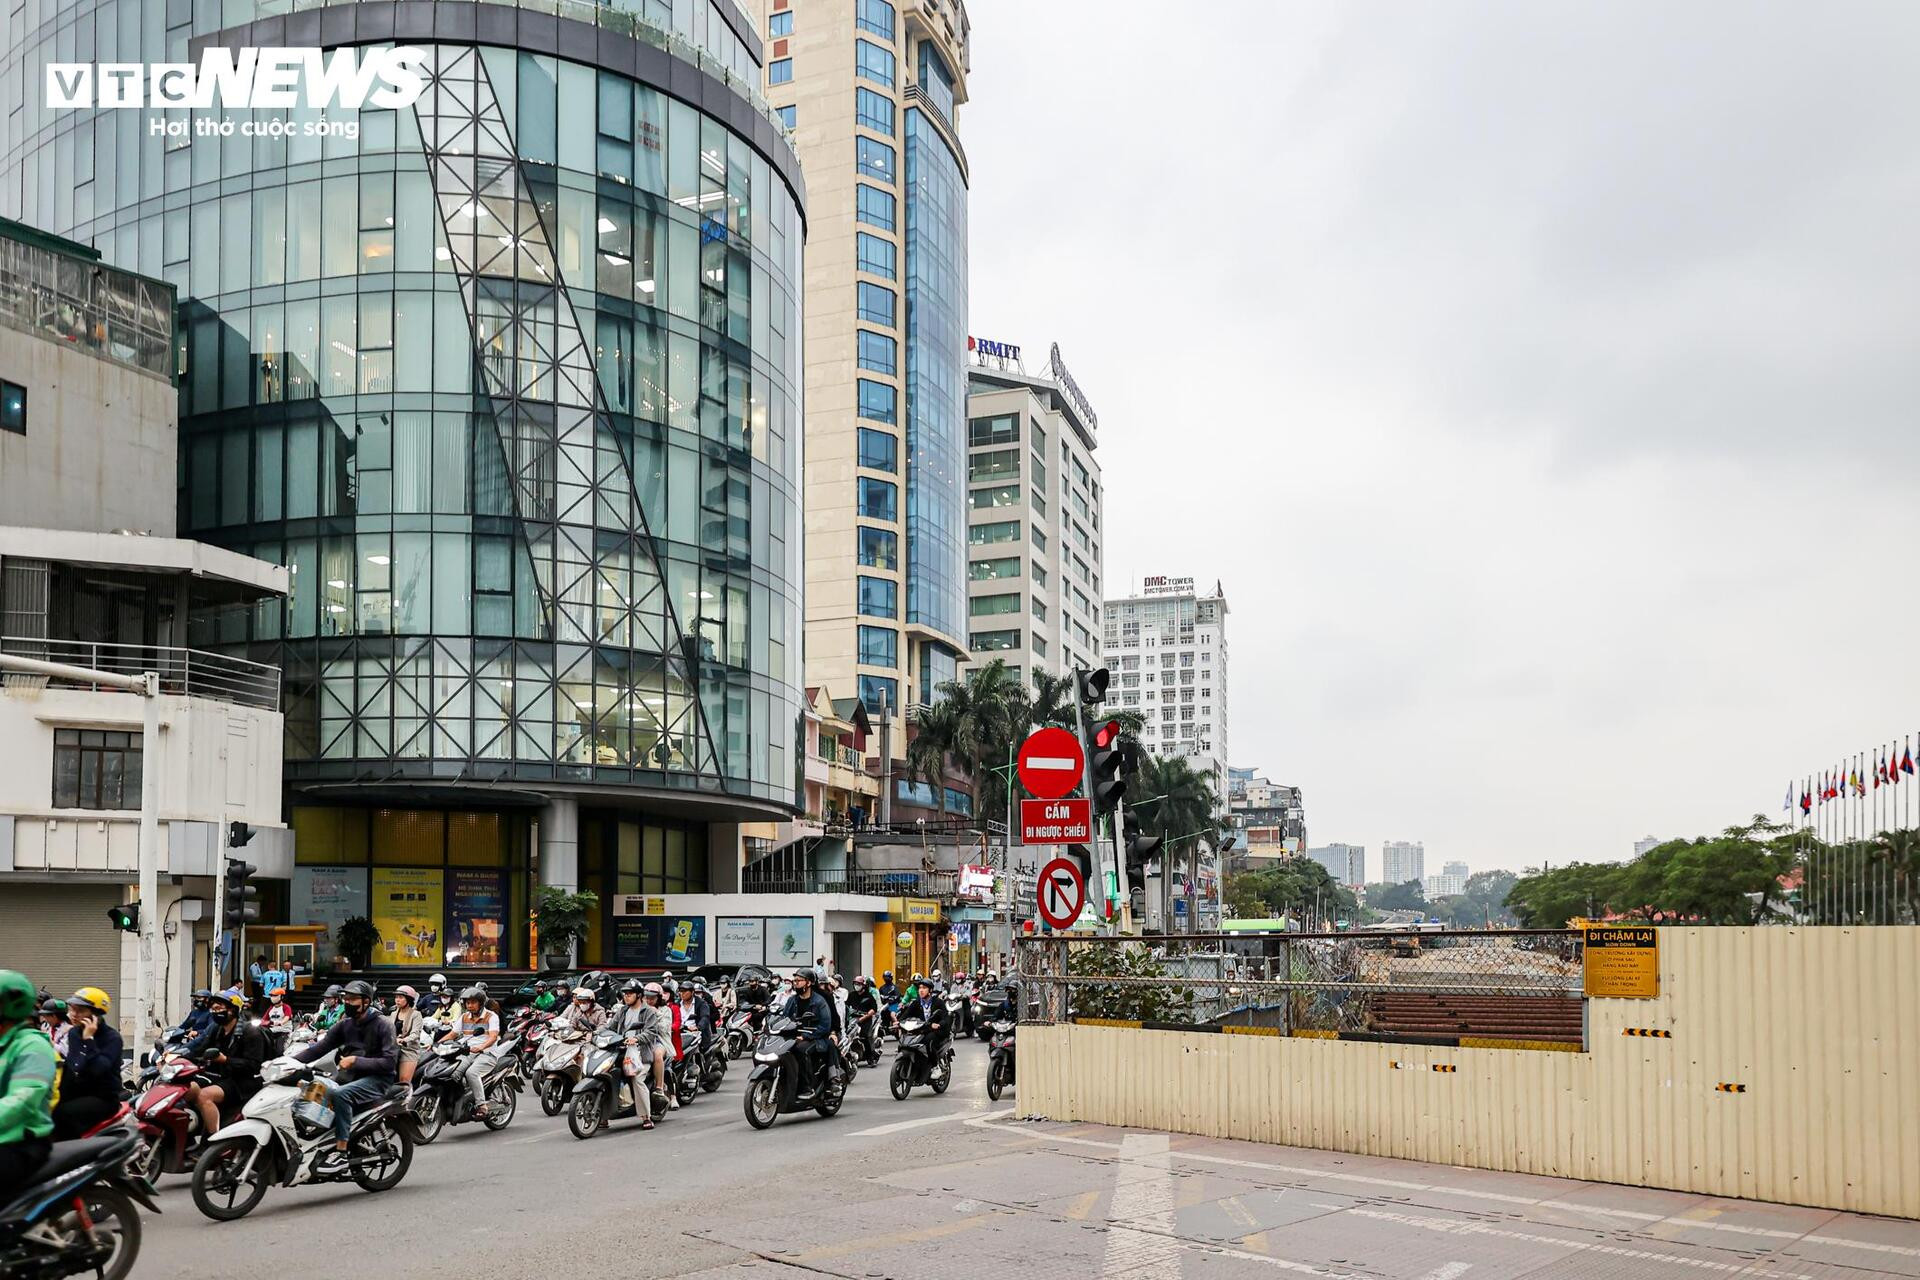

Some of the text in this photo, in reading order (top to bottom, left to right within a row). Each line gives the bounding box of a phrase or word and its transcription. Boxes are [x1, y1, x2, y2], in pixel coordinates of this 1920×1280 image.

[977, 338, 1020, 361] RMIT
[1144, 575, 1194, 587] DMC TOWER
[1045, 801, 1070, 820] CẤM
[1026, 826, 1034, 838] ĐI
[1035, 825, 1062, 840] NGƯỢC
[910, 906, 920, 914] NAM
[924, 906, 935, 915] BANK
[1589, 930, 1653, 942] ĐI CHẬM LẠI
